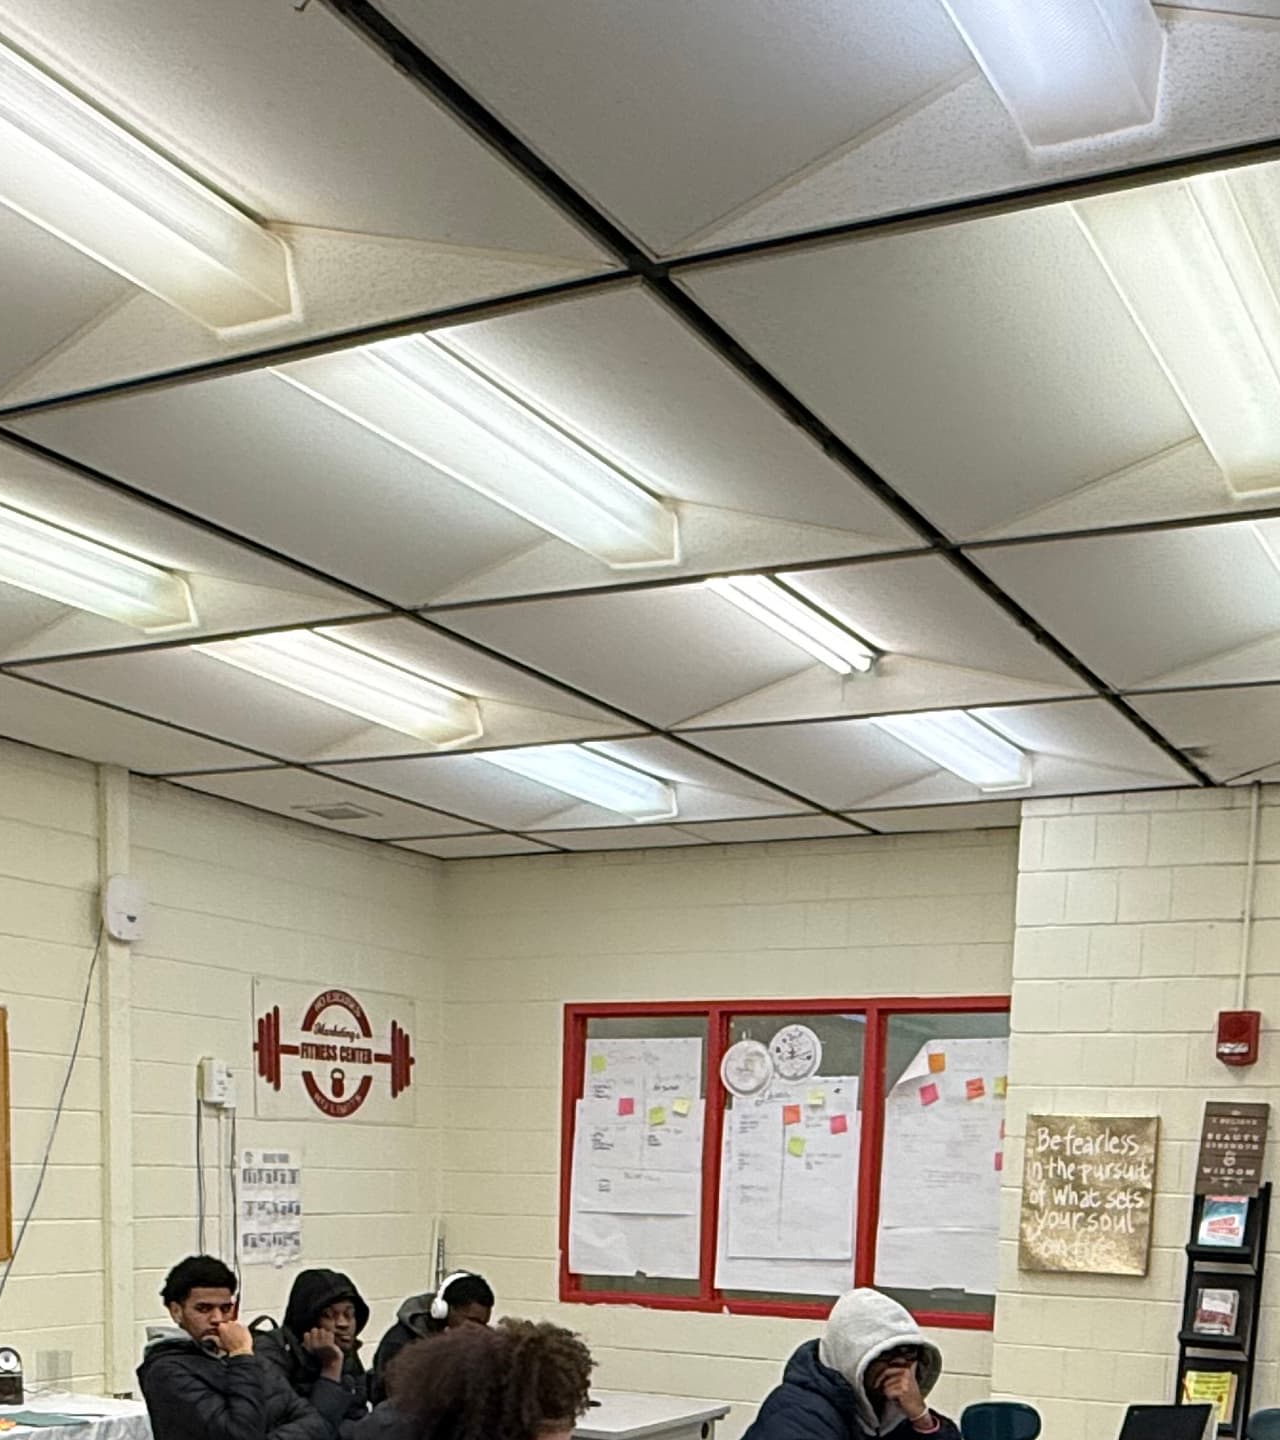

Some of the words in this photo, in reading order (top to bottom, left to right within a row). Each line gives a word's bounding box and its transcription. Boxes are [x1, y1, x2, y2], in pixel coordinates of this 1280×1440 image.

[300, 1042, 337, 1062] FITNESS
[339, 1045, 373, 1065] CENTER
[1036, 1126, 1062, 1153] Be
[1063, 1123, 1140, 1156] fearless
[1206, 1132, 1261, 1143] BEAUTY
[1043, 1155, 1077, 1181] the
[1077, 1159, 1151, 1185] pursuit
[1201, 1166, 1256, 1177] WISDOM
[1028, 1179, 1047, 1209] of
[1104, 1186, 1145, 1210] sets
[1027, 1208, 1085, 1242] your
[1086, 1208, 1135, 1234] soul
